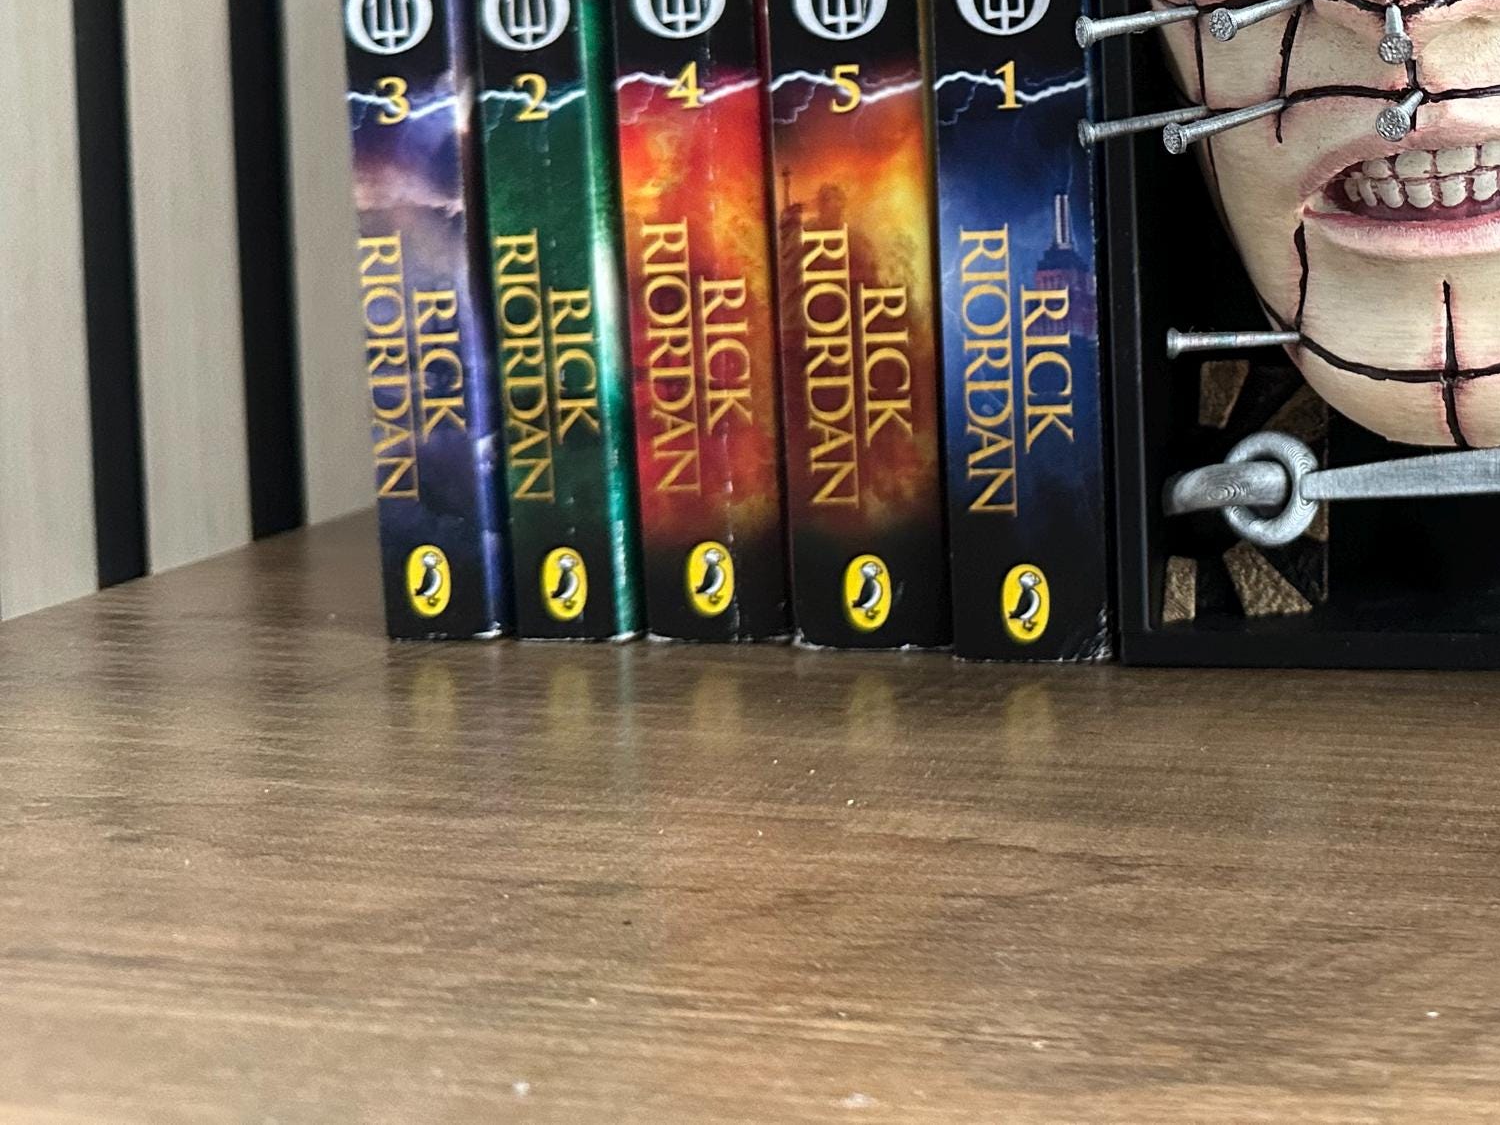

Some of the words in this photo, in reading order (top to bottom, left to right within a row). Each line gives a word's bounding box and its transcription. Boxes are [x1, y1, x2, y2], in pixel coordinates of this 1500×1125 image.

[376, 76, 410, 125] 3
[514, 73, 549, 122] 2
[666, 61, 704, 109] 4
[832, 63, 862, 114] 5
[995, 59, 1023, 110] 1
[358, 231, 419, 501] RIORDAN
[413, 287, 467, 439] RICK
[495, 228, 556, 504] RIORDAN
[546, 286, 600, 445] RICK
[640, 216, 700, 495] RIORDAN
[700, 275, 753, 436] RICK
[800, 223, 860, 509] RIORDAN
[861, 282, 913, 448] RICK
[958, 223, 1018, 518] RIORDAN
[1019, 284, 1075, 455] RICK
